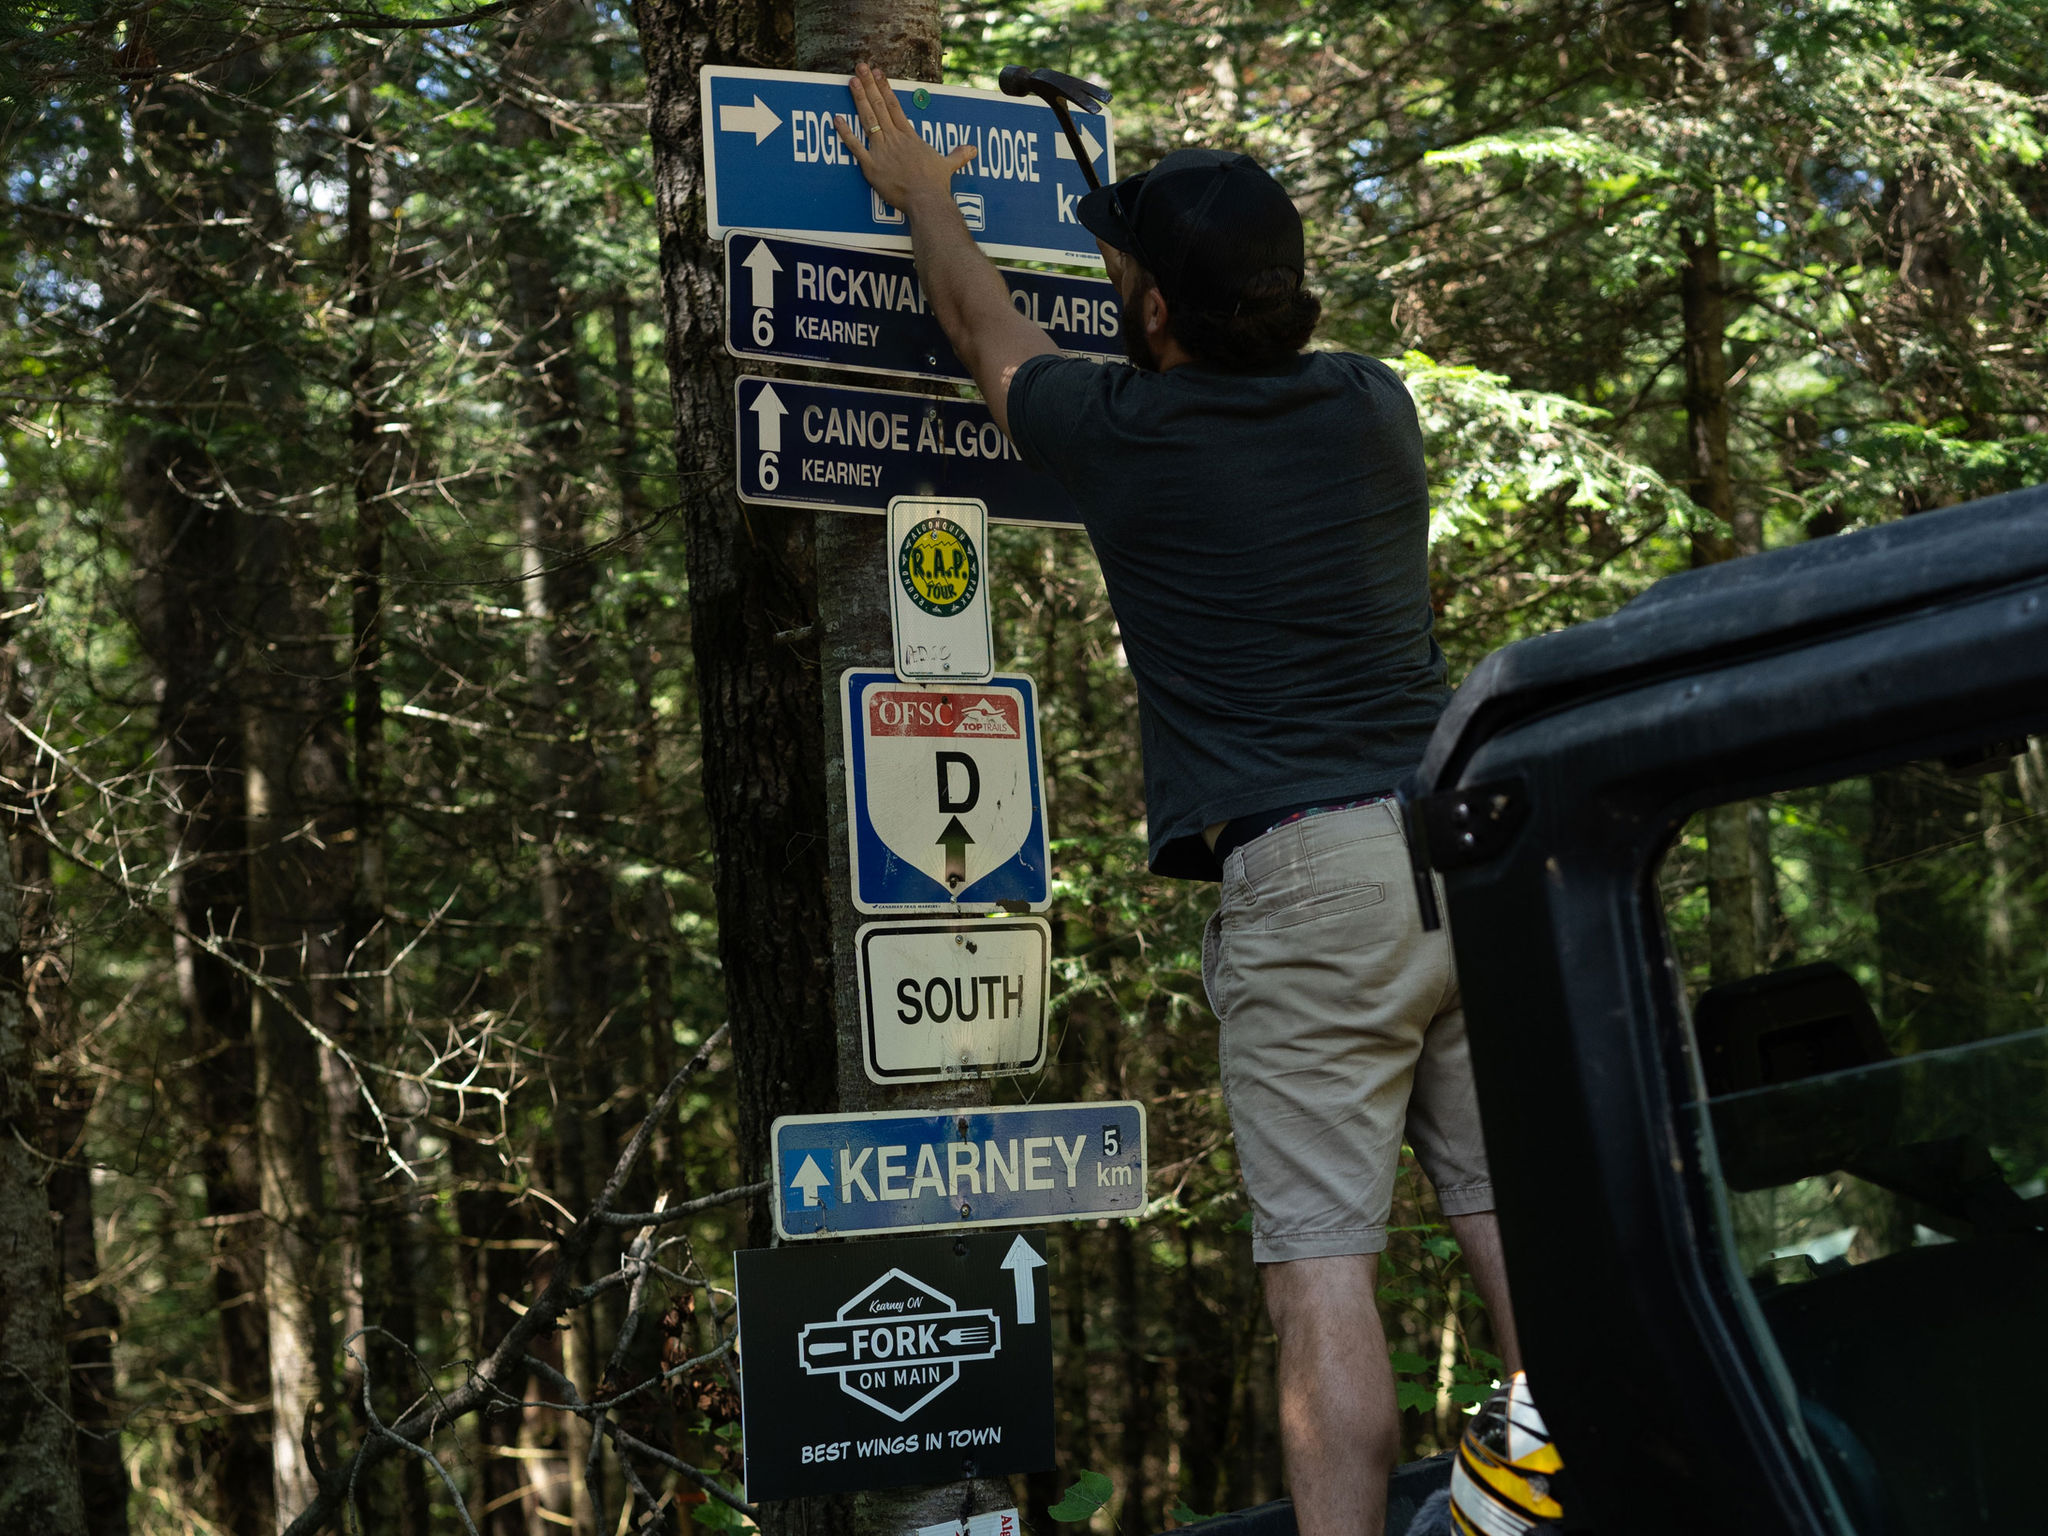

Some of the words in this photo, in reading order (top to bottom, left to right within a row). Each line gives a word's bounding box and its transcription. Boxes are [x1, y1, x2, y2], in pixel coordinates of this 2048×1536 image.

[977, 126, 1040, 182] LODGE
[1056, 183, 1083, 226] k
[752, 307, 775, 347] 6
[795, 315, 880, 348] KEARNEY
[1010, 289, 1119, 339] OLARIS
[802, 404, 910, 452] CANOE
[758, 451, 780, 491] 6
[801, 458, 883, 488] KEARNEY
[911, 521, 966, 541] ALGONQUIN
[926, 583, 957, 599] TOUR
[878, 700, 954, 726] OFSC
[936, 751, 980, 814] D
[896, 975, 1024, 1025] SOUTH
[1103, 1129, 1119, 1157] 5
[839, 1135, 1087, 1204] KEARNEY
[1097, 1162, 1132, 1188] km
[869, 1299, 905, 1313] Kearney
[907, 1296, 924, 1309] ON
[852, 1323, 940, 1361] FORK
[859, 1371, 886, 1390] ON
[893, 1366, 940, 1387] MAIN
[801, 1441, 851, 1464] BEST
[856, 1434, 919, 1458] WINGS
[926, 1432, 942, 1451] IN
[947, 1426, 1002, 1449] TOWN
